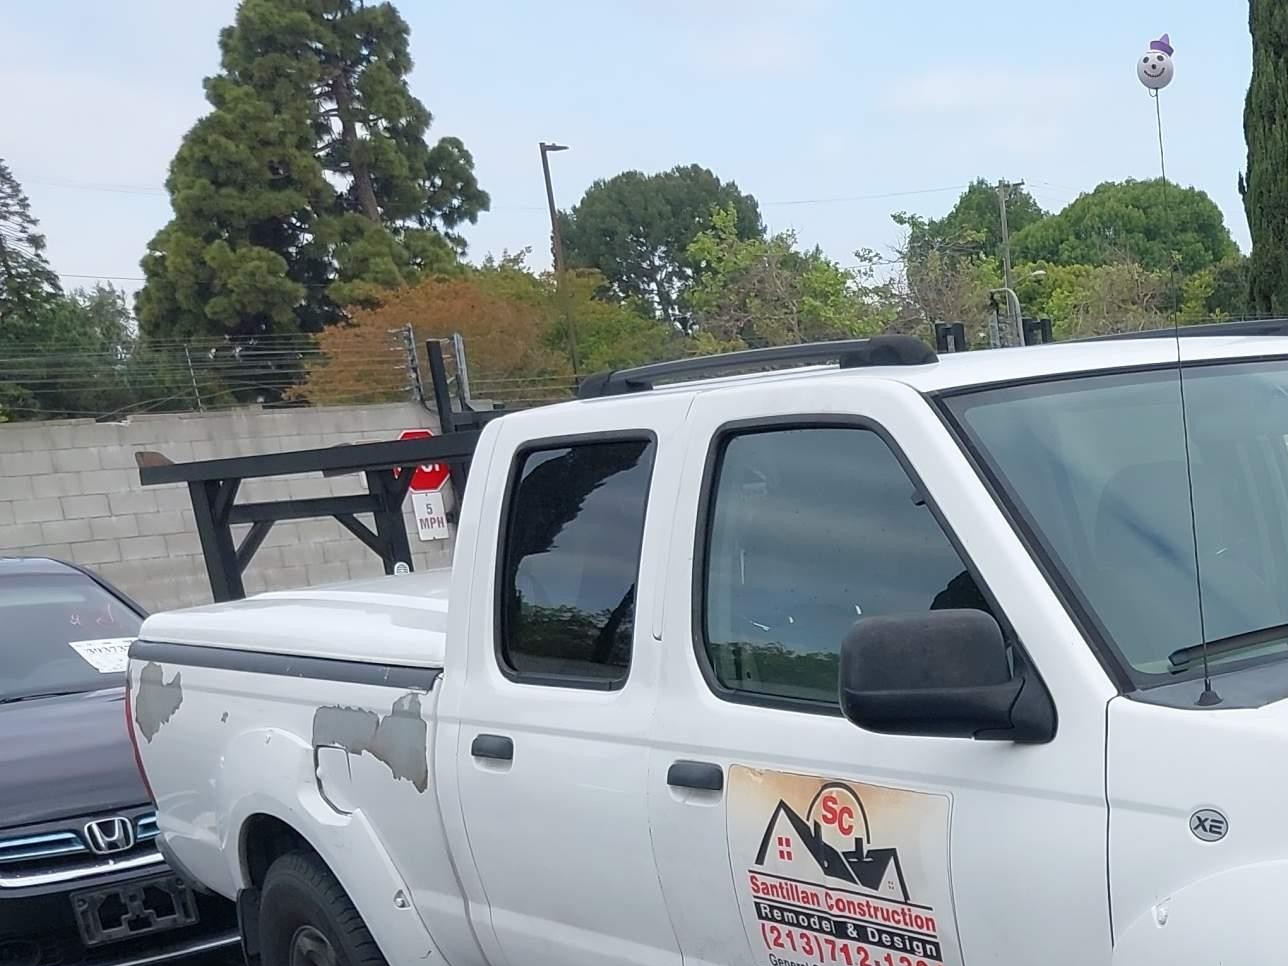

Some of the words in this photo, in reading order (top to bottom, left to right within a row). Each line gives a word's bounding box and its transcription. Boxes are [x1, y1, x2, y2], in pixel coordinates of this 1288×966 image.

[419, 516, 446, 530] MPH
[426, 503, 433, 515] 5
[821, 794, 855, 836] SC
[1193, 815, 1225, 836] XE
[750, 874, 821, 908] Santillan
[824, 891, 937, 933] Construction
[760, 904, 836, 935] Remodel
[846, 922, 859, 939] &
[867, 927, 938, 957] Design
